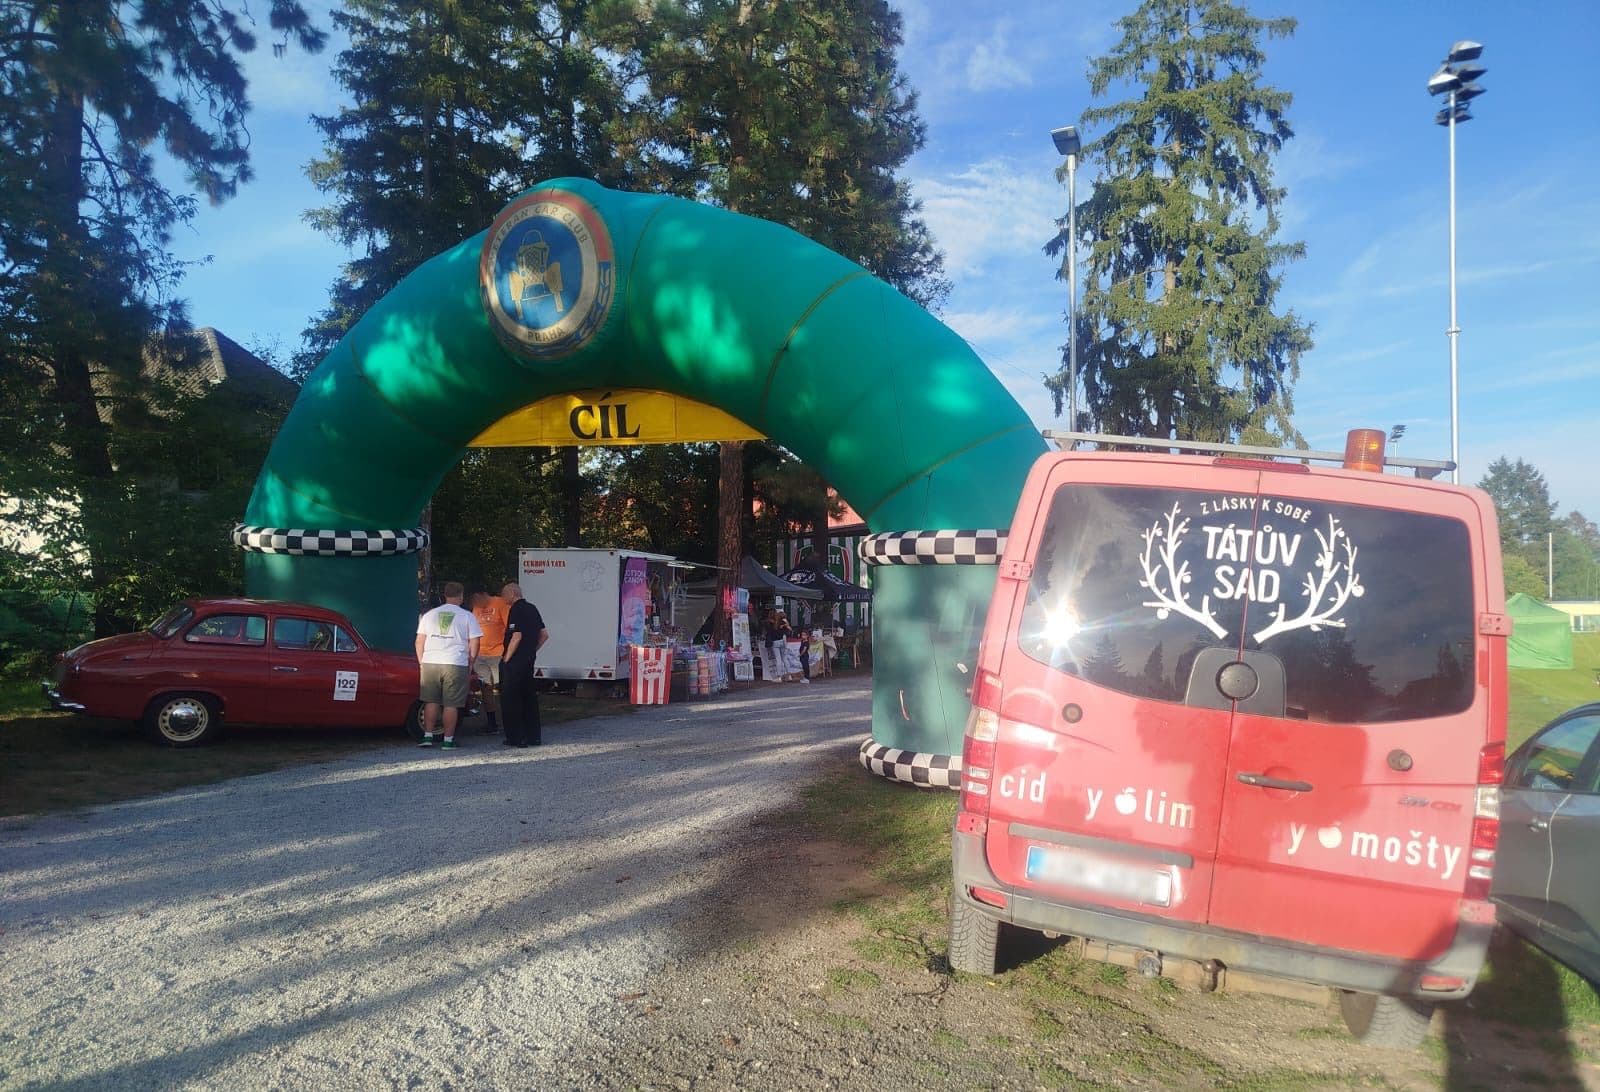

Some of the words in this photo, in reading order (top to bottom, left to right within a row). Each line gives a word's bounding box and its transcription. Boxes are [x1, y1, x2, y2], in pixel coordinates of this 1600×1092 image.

[563, 213, 588, 244] CLUB
[527, 326, 566, 342] PRAHA
[569, 391, 641, 440] CÍL
[1200, 502, 1210, 515] Z
[1262, 499, 1271, 511] K
[1274, 501, 1312, 523] SOBĚ
[1202, 523, 1302, 567] TÁTŮV
[1213, 565, 1281, 603] SAD
[338, 679, 356, 689] 122
[1350, 830, 1462, 880] mošty
